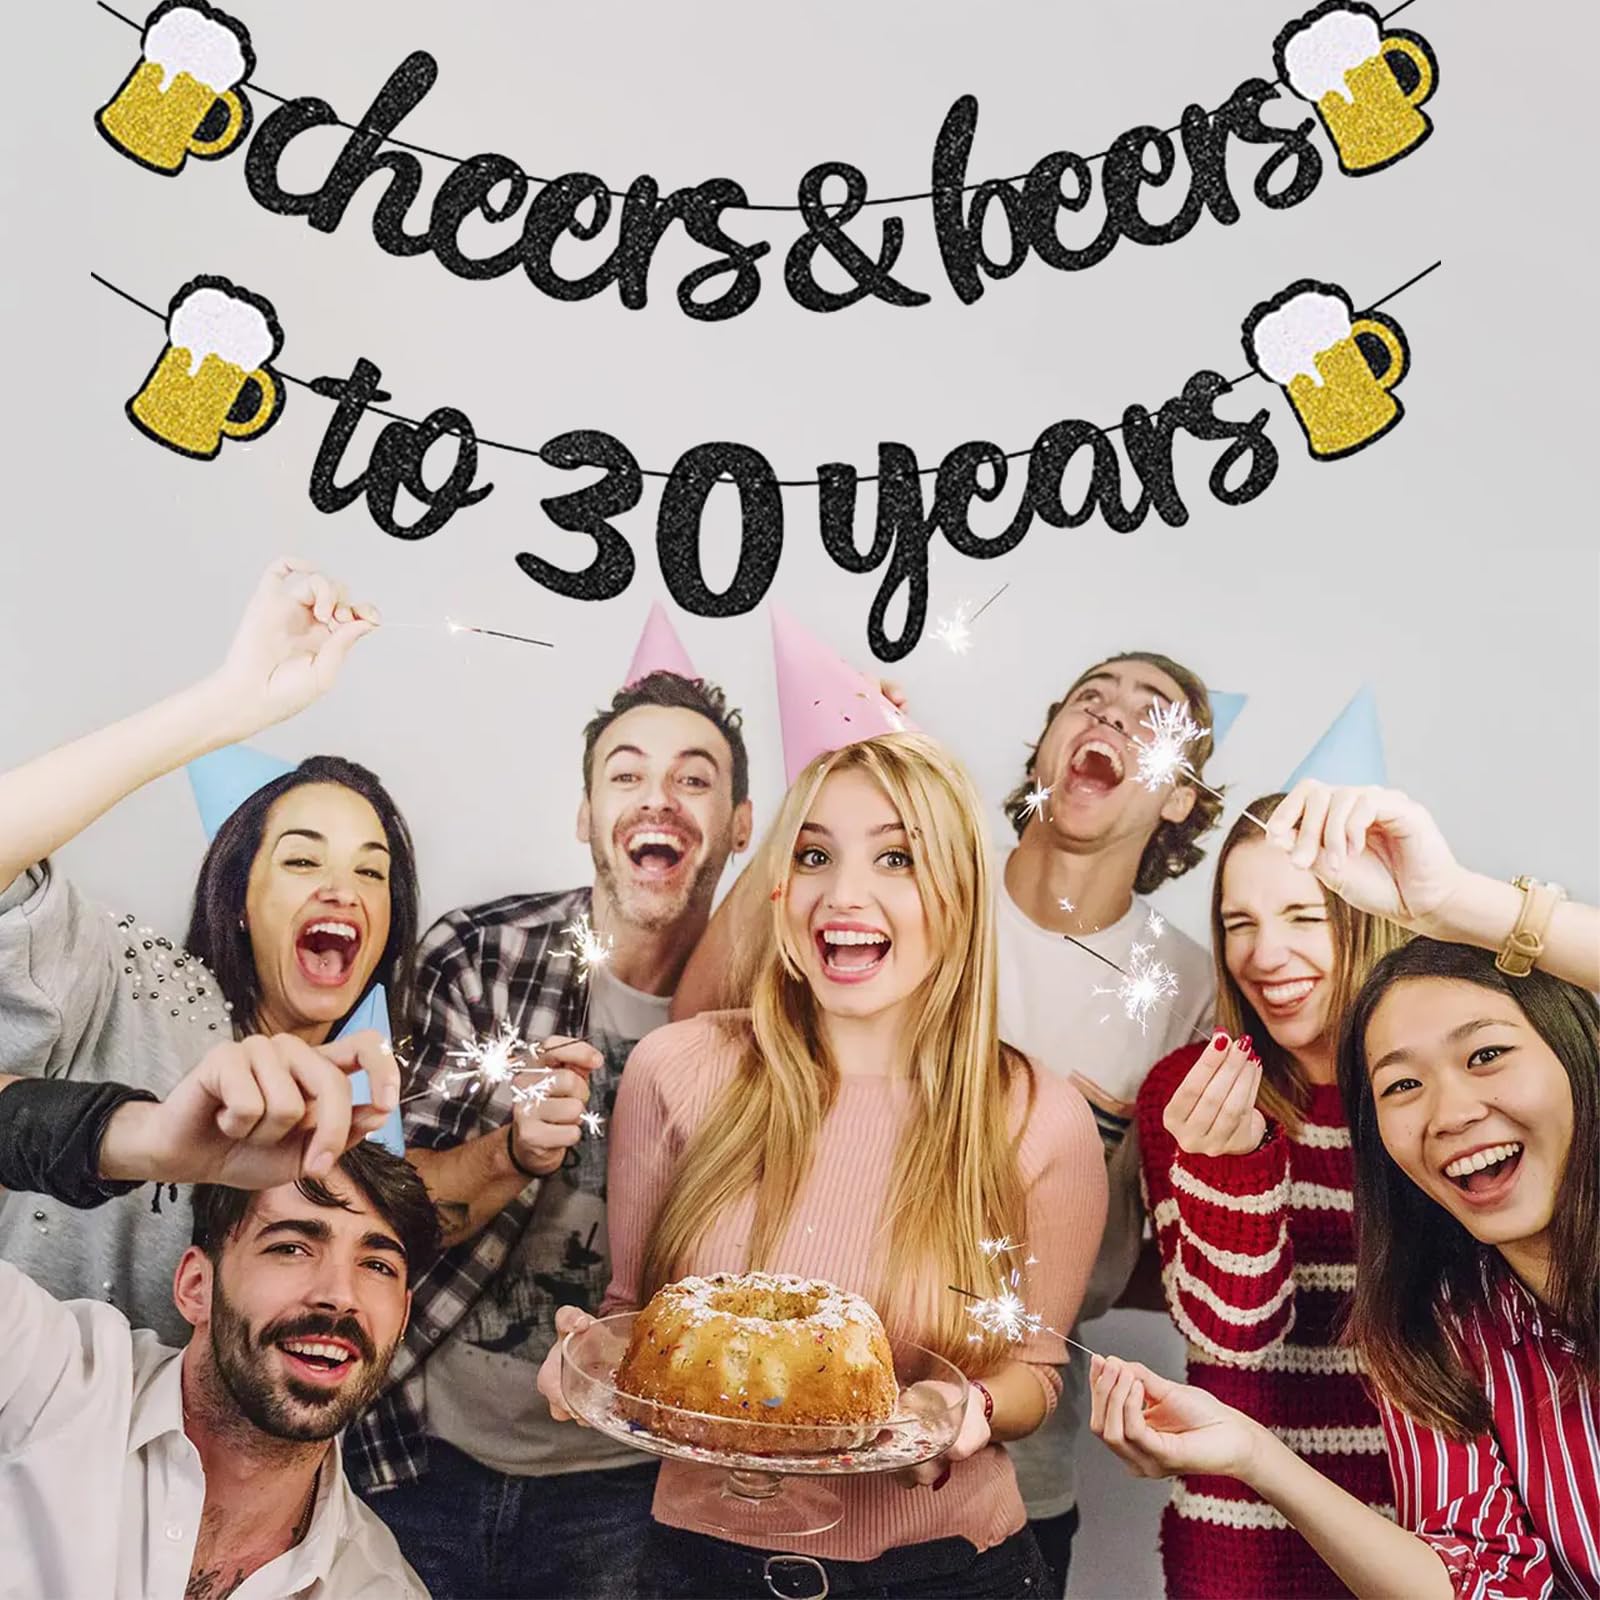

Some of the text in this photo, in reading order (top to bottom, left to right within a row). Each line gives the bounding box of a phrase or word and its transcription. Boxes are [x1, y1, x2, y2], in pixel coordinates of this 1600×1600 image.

[245, 51, 1323, 321] cheers & beers
[310, 357, 1279, 663] to 30 years
